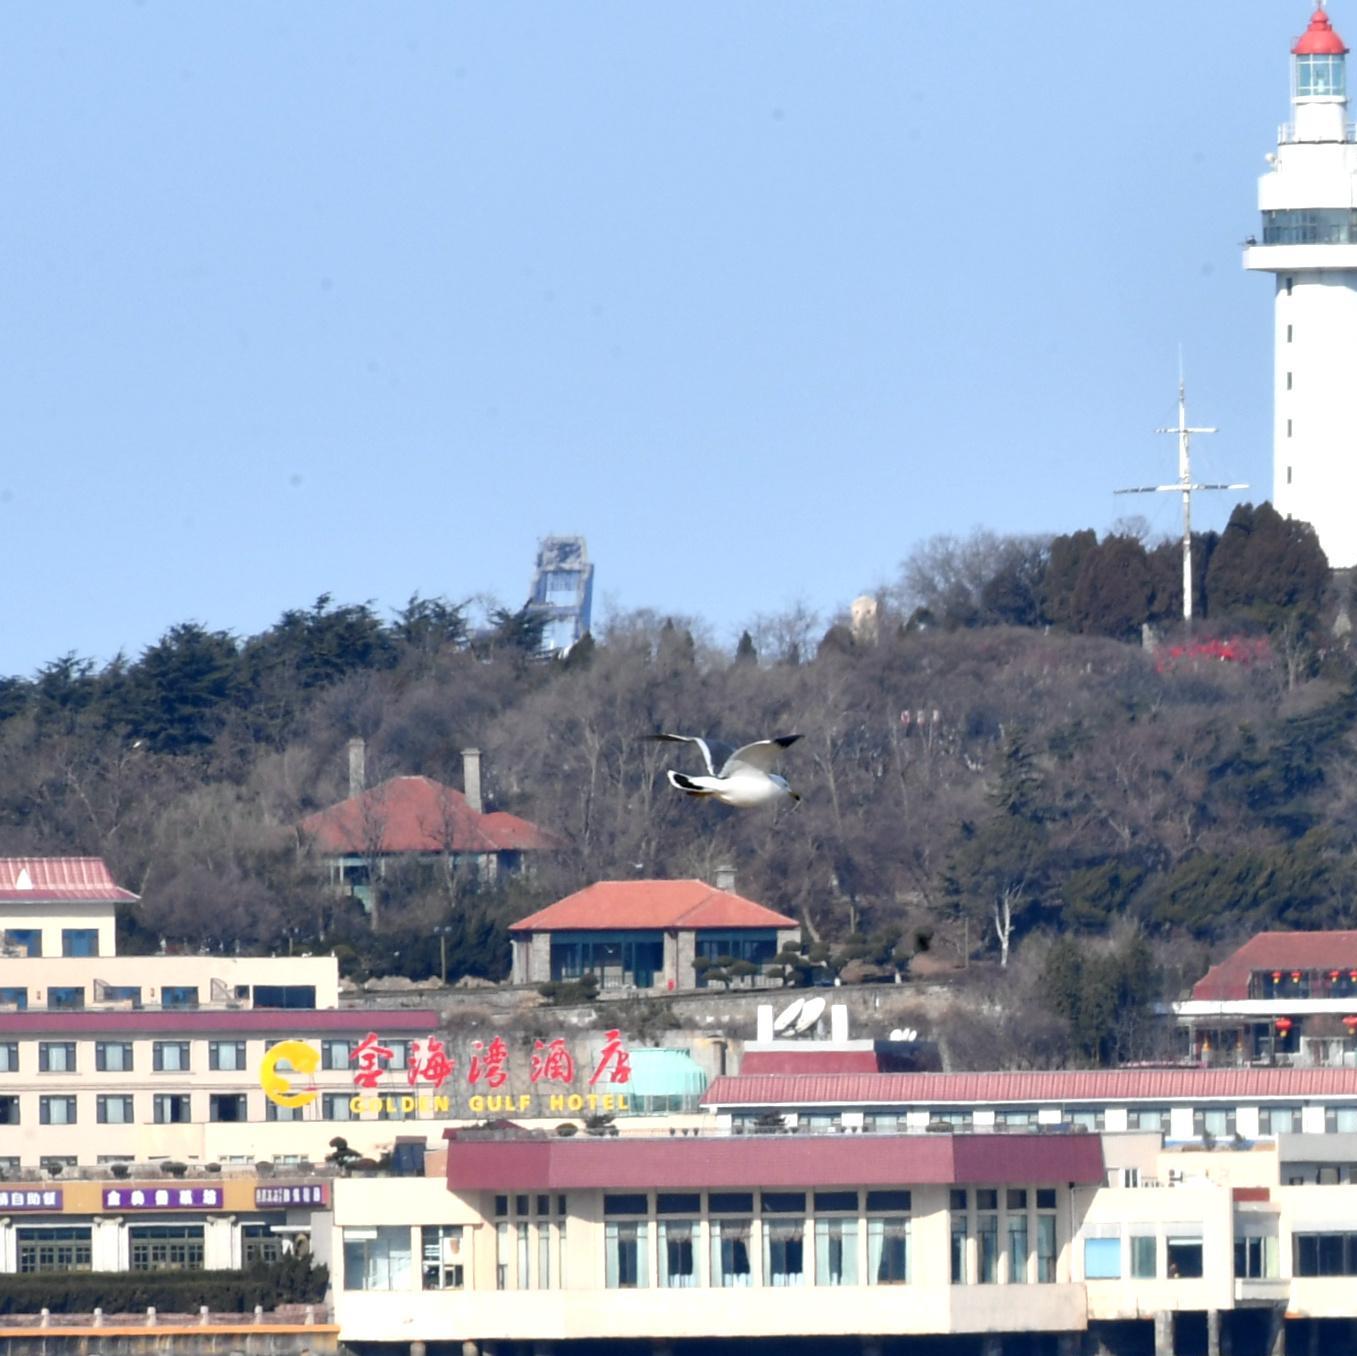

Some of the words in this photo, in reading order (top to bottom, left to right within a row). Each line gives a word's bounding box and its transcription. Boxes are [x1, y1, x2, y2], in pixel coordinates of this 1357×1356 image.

[350, 1028, 632, 1088] 金海湾酒店
[350, 1095, 449, 1113] GOLDEN
[468, 1094, 531, 1112] GULF
[550, 1093, 630, 1111] HOTEL
